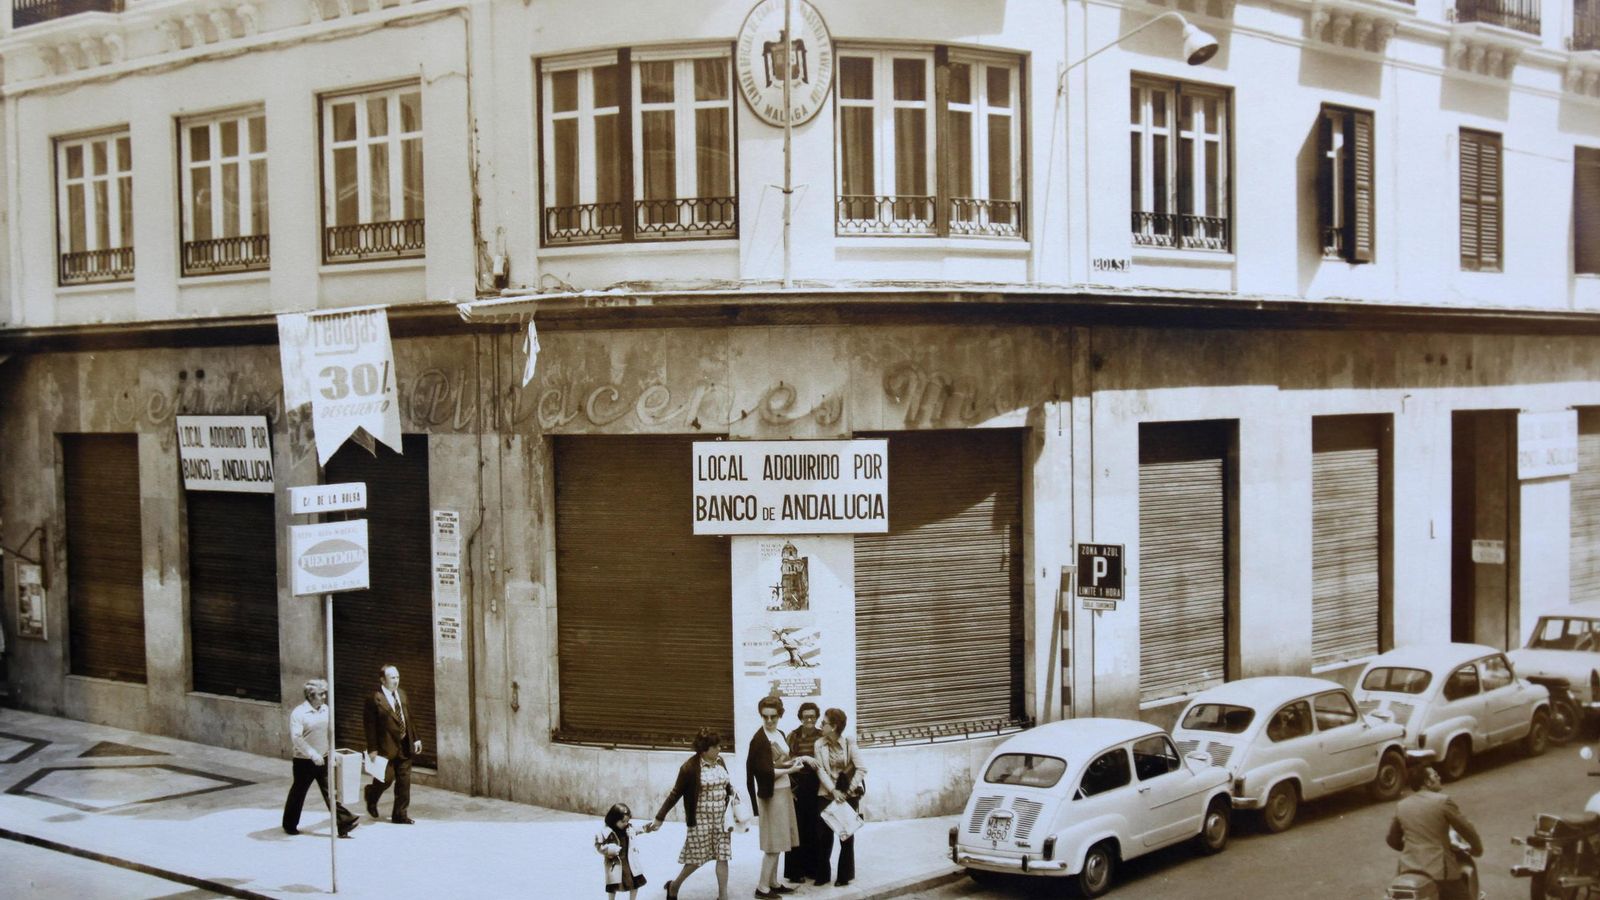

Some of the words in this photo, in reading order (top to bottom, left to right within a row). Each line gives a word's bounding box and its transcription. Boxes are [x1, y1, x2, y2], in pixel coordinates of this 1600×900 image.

[180, 426, 204, 448] LOCAL
[209, 426, 247, 448] ADQUIRIDO
[251, 426, 268, 448] POR
[182, 458, 212, 480] BANCO
[213, 468, 221, 480] DE
[222, 458, 274, 483] ANDALUCIA
[698, 454, 748, 481] LOCAL
[763, 454, 840, 481] ADQUIRIDO
[854, 453, 882, 480] POR
[317, 495, 324, 505] DE
[328, 494, 337, 504] LA
[696, 494, 757, 521] BANCO
[762, 507, 775, 521] DE
[781, 493, 885, 521] ANDALUCIA
[1081, 546, 1097, 555] ZONA
[1103, 547, 1119, 557] AZUL
[1093, 556, 1107, 586] P
[1079, 586, 1097, 596] LIMITE
[1105, 588, 1121, 597] HORA
